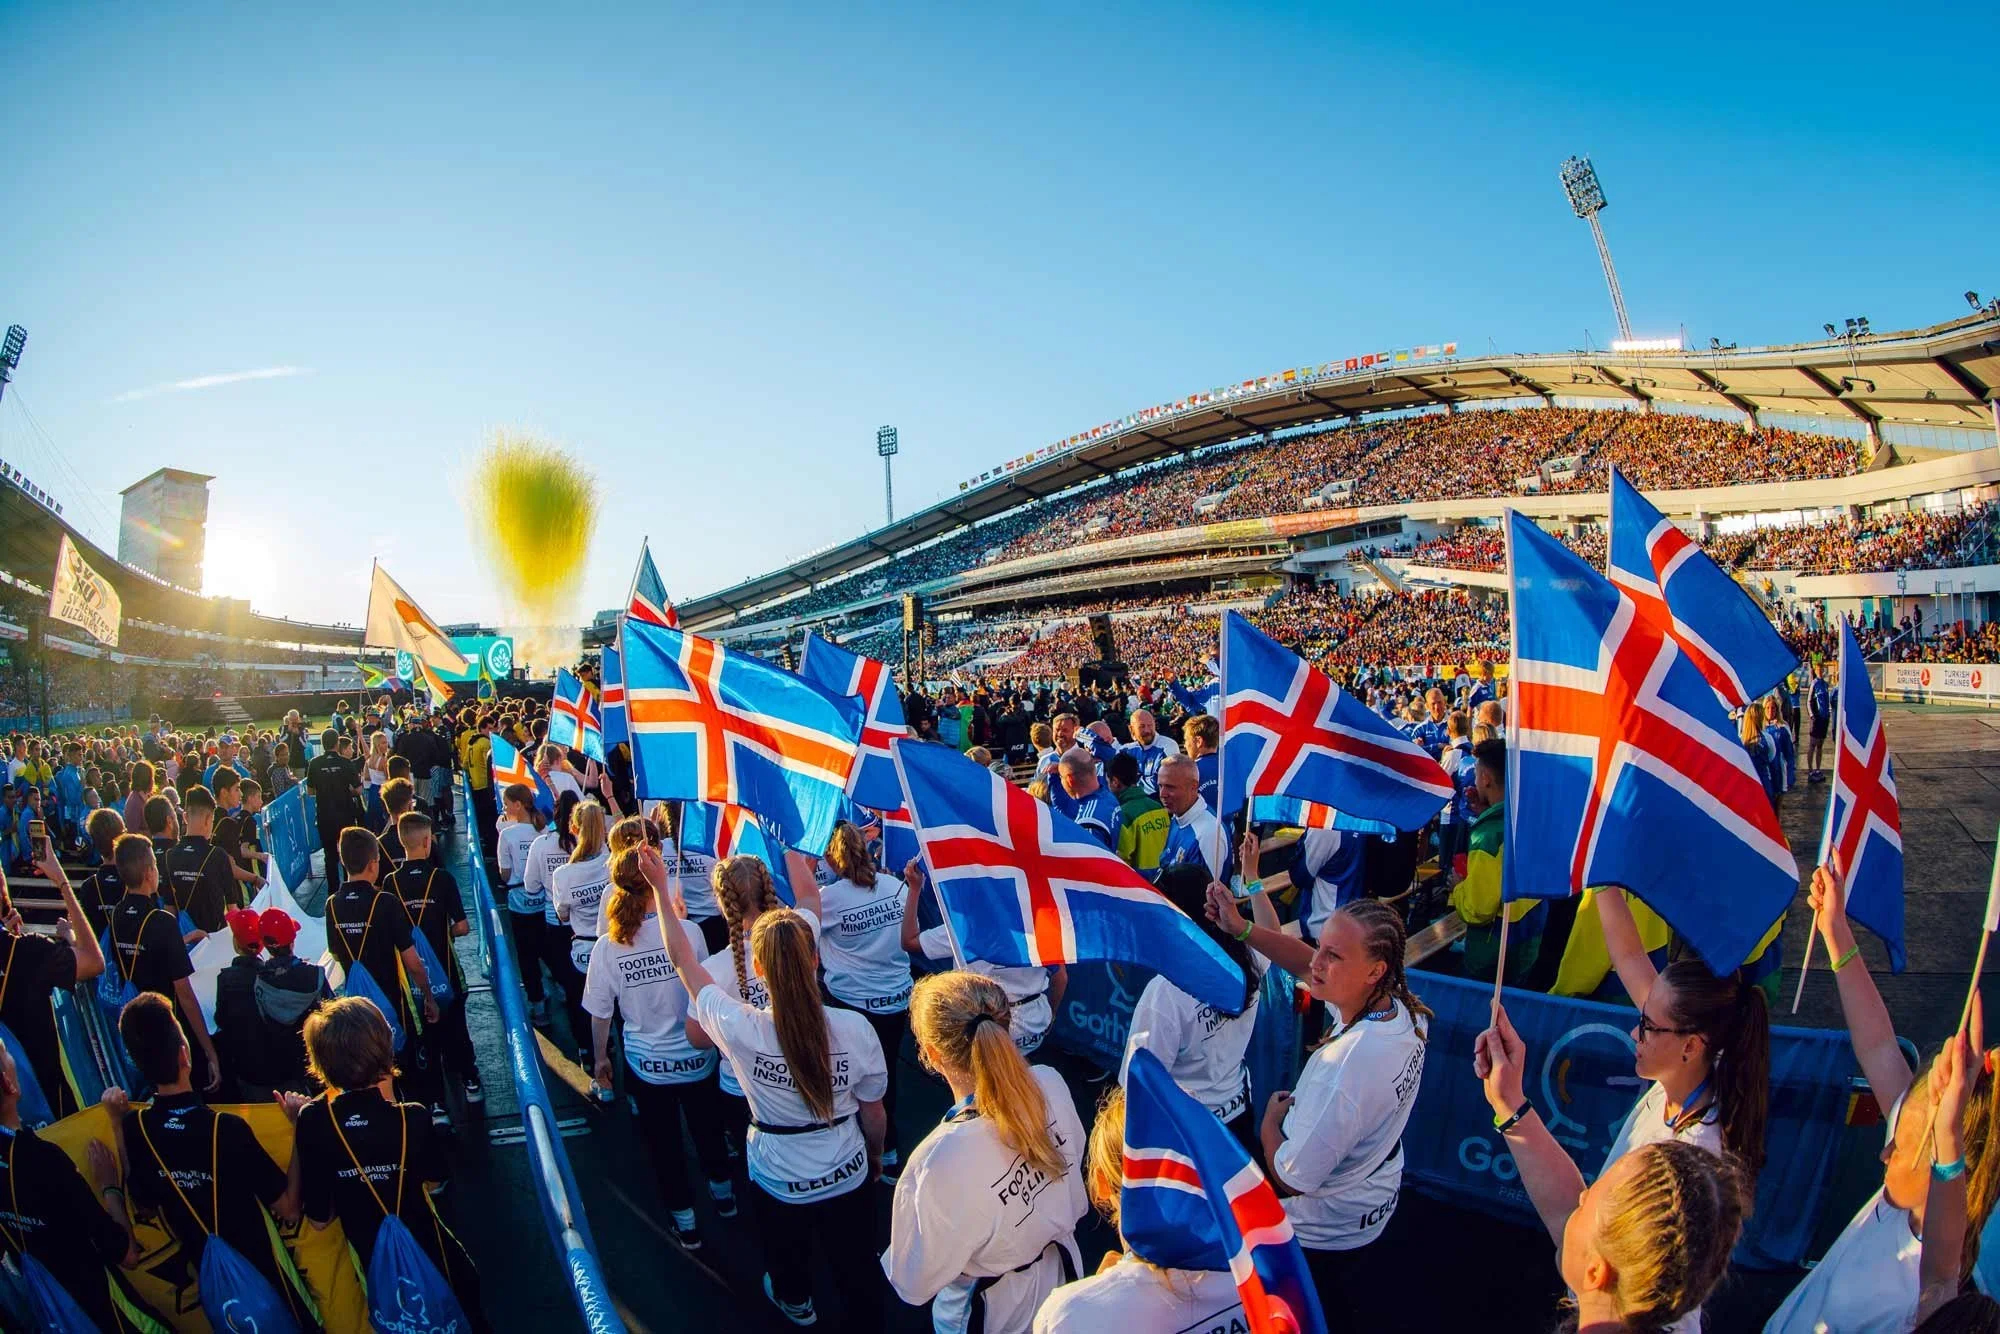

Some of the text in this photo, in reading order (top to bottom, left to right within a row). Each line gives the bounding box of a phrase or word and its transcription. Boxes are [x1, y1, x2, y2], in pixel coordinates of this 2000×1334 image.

[1897, 668, 1920, 677] TURKISH
[1897, 677, 1920, 685] AIRLINES
[1944, 670, 1970, 679] TURKISH
[1944, 678, 1970, 687] AIRLINES
[842, 899, 901, 924] FOOTBALL IS
[841, 908, 905, 933] MINDFULNESS
[618, 953, 670, 973] FOOTBAL
[624, 965, 677, 982] POTENTIA
[1068, 1001, 1129, 1046] Gothi
[638, 1057, 706, 1073] ICELAND
[836, 1060, 849, 1073] IS
[753, 1066, 849, 1090] INSPION
[787, 1150, 865, 1194] ICELAND
